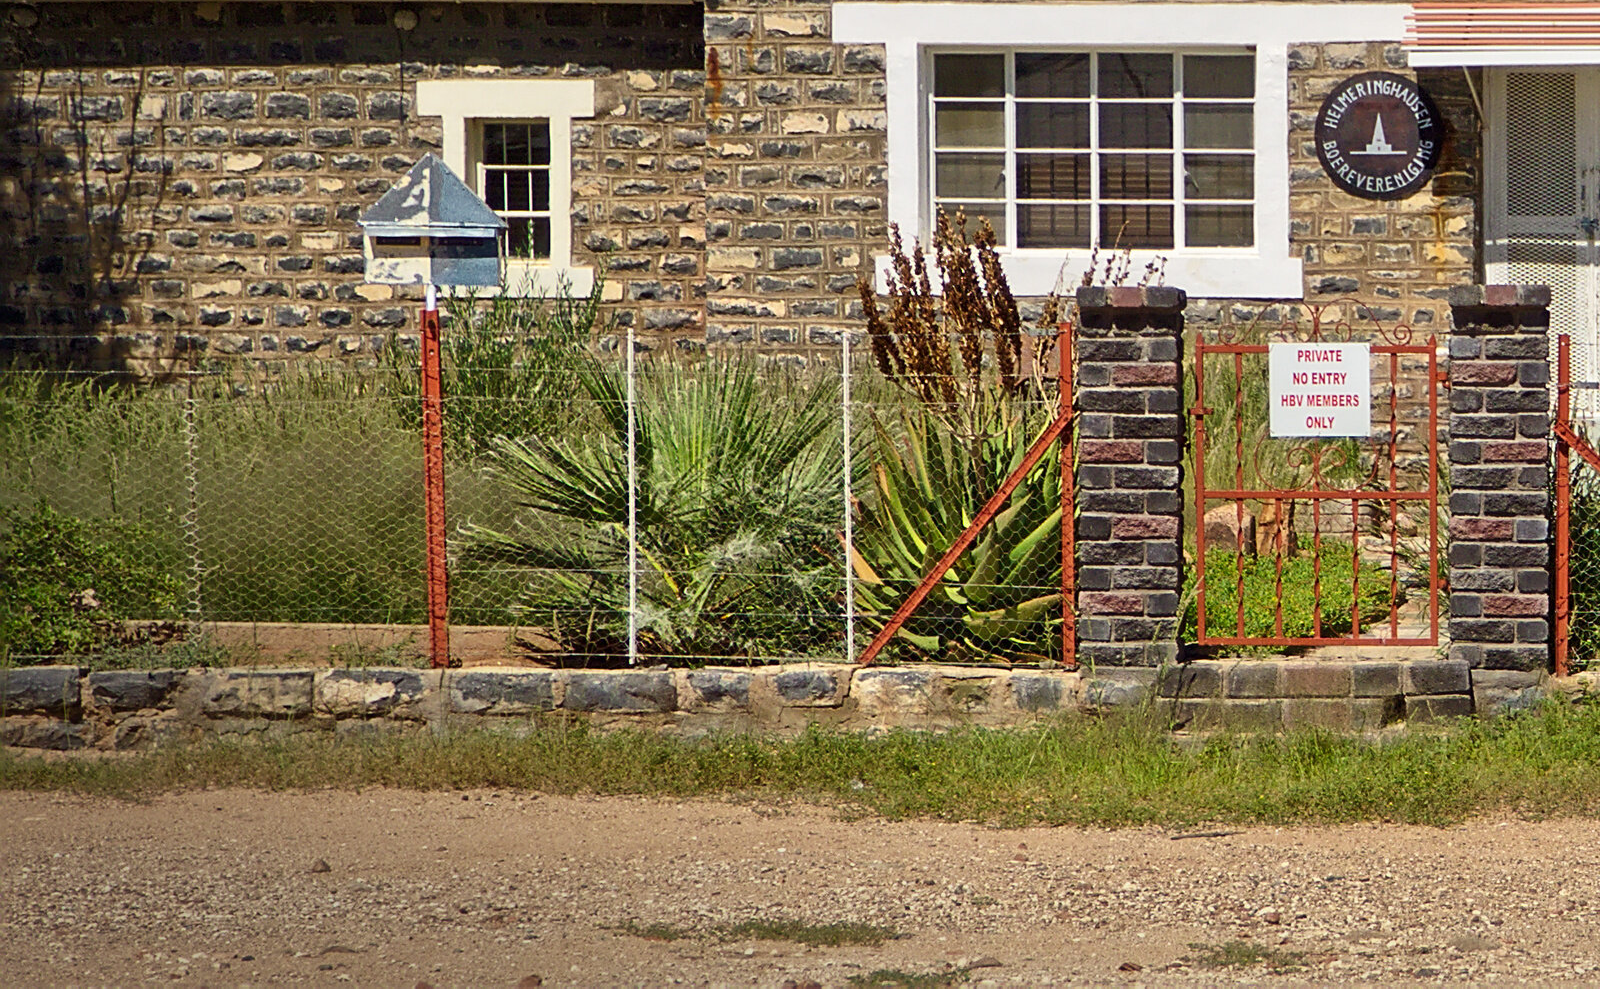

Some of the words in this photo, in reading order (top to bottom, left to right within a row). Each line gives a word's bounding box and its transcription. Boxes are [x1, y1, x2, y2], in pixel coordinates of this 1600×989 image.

[1324, 80, 1433, 129] HELMERINGHAUSEN
[1322, 139, 1434, 192] BOEREVERENIGING
[1297, 350, 1342, 362] PRIVATE
[1293, 372, 1308, 384] NO
[1312, 372, 1347, 384] ENTRY
[1281, 395, 1303, 407] HBV
[1307, 395, 1359, 407] MEMBERS
[1306, 416, 1334, 428] ONLY
